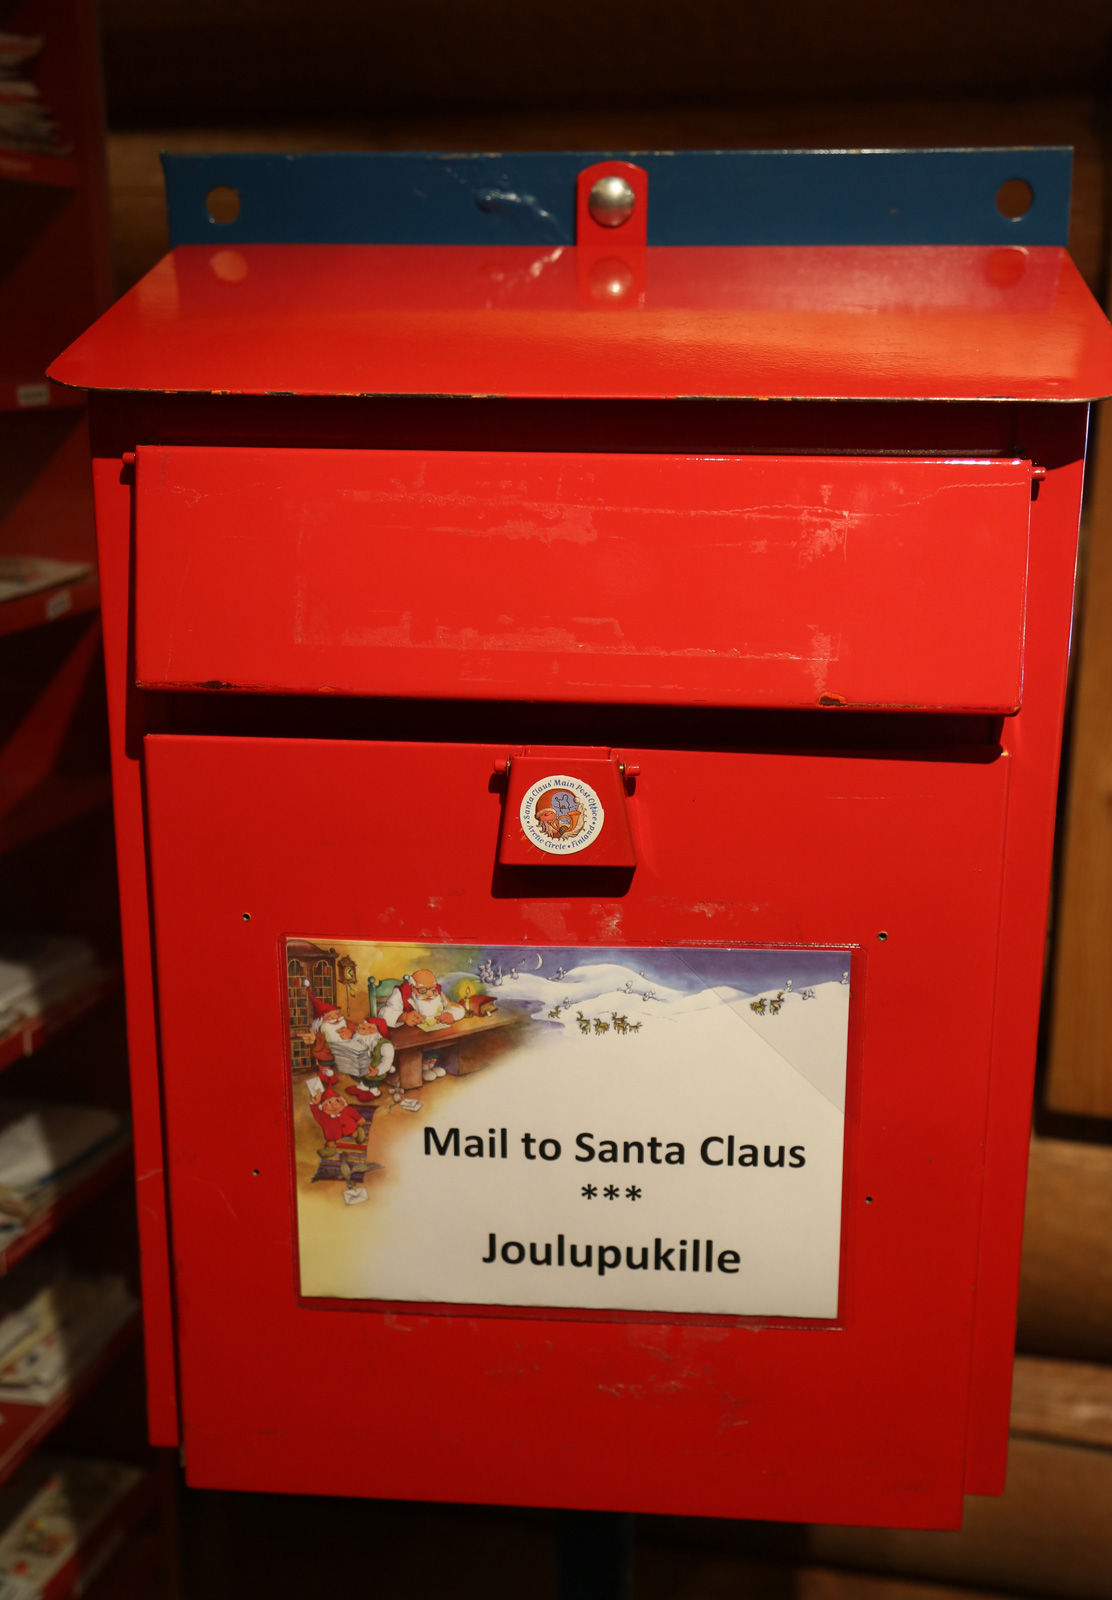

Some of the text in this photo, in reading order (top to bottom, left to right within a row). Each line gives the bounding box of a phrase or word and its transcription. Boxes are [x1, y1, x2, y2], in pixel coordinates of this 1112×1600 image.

[524, 796, 534, 820] Santa
[554, 779, 575, 788] Main
[576, 784, 590, 799] Post
[588, 796, 598, 821] Office
[527, 824, 595, 850] Arctic Circle Finland
[423, 1126, 807, 1169] Mail to Santa Claus
[482, 1233, 741, 1276] Joulupukille
